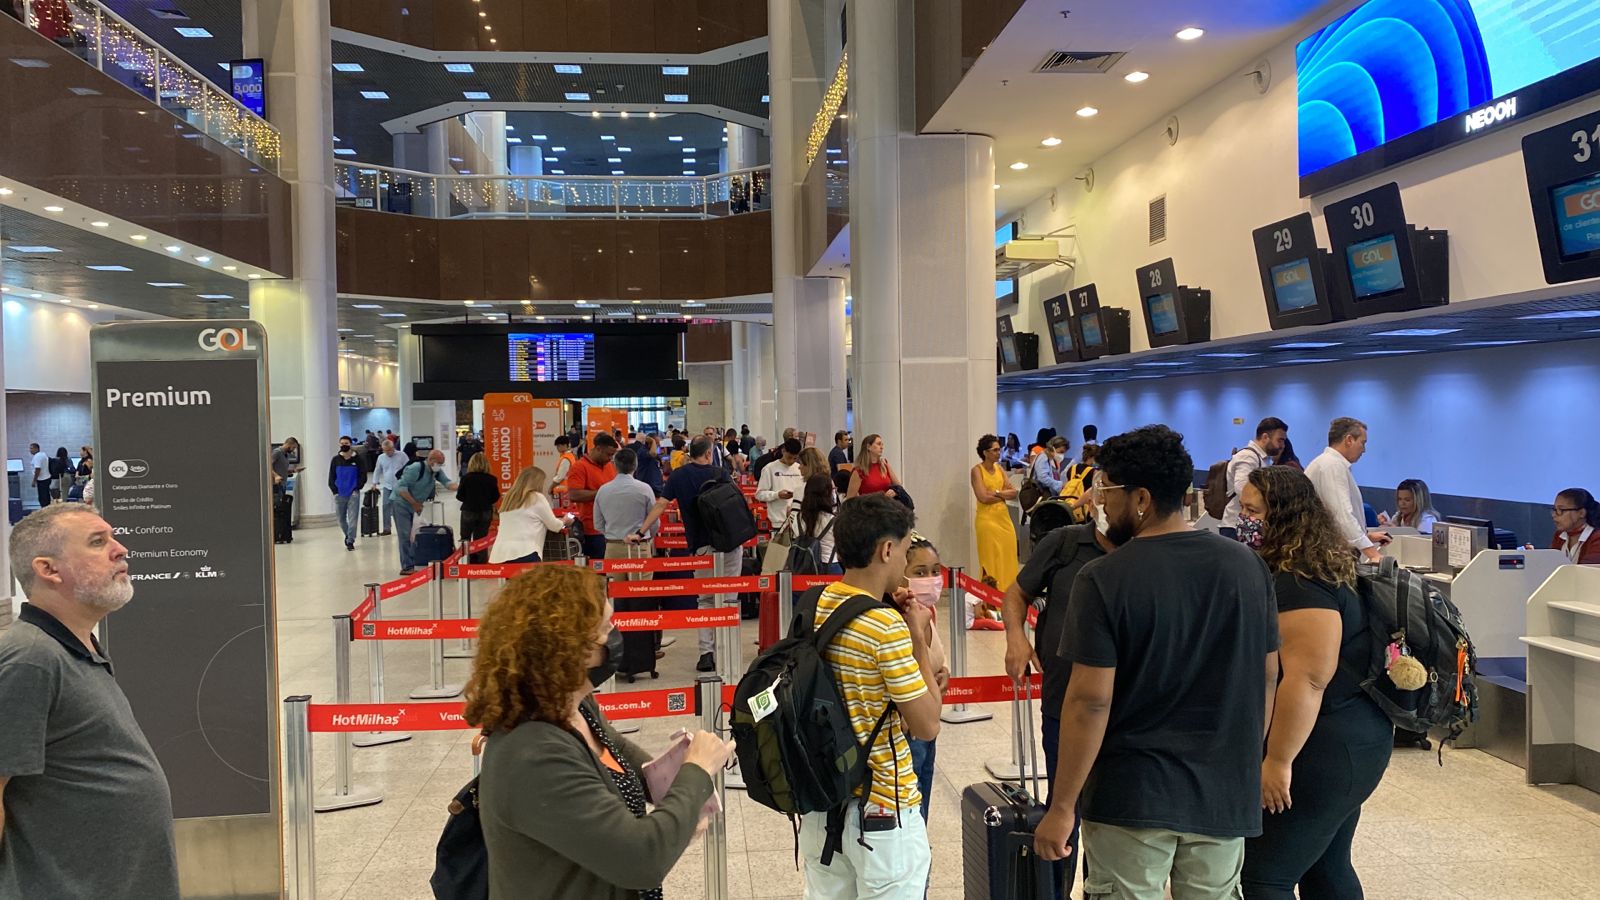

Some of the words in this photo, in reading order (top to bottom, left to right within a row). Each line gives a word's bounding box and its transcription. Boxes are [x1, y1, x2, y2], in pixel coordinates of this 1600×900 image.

[1466, 97, 1517, 133] NEOOH
[1580, 191, 1600, 210] GO
[1351, 202, 1374, 230] 30
[1274, 228, 1293, 252] 29
[1362, 249, 1384, 264] GOL
[1150, 269, 1162, 288] 28
[1079, 291, 1088, 307] 27
[1052, 302, 1061, 316] 26
[198, 328, 256, 351] GOL
[106, 386, 211, 407] Premium
[501, 427, 511, 480] ORLANDO
[135, 525, 173, 534] Conforto
[1435, 530, 1444, 544] 30
[131, 549, 168, 558] Premium
[170, 549, 208, 558] Economy
[131, 572, 171, 580] FRANCE
[614, 619, 659, 627] HotMilhas
[387, 627, 433, 636] HotMilhas
[599, 700, 651, 711] has.com.br
[332, 714, 399, 726] HotMilhas
[440, 712, 464, 721] Ven
